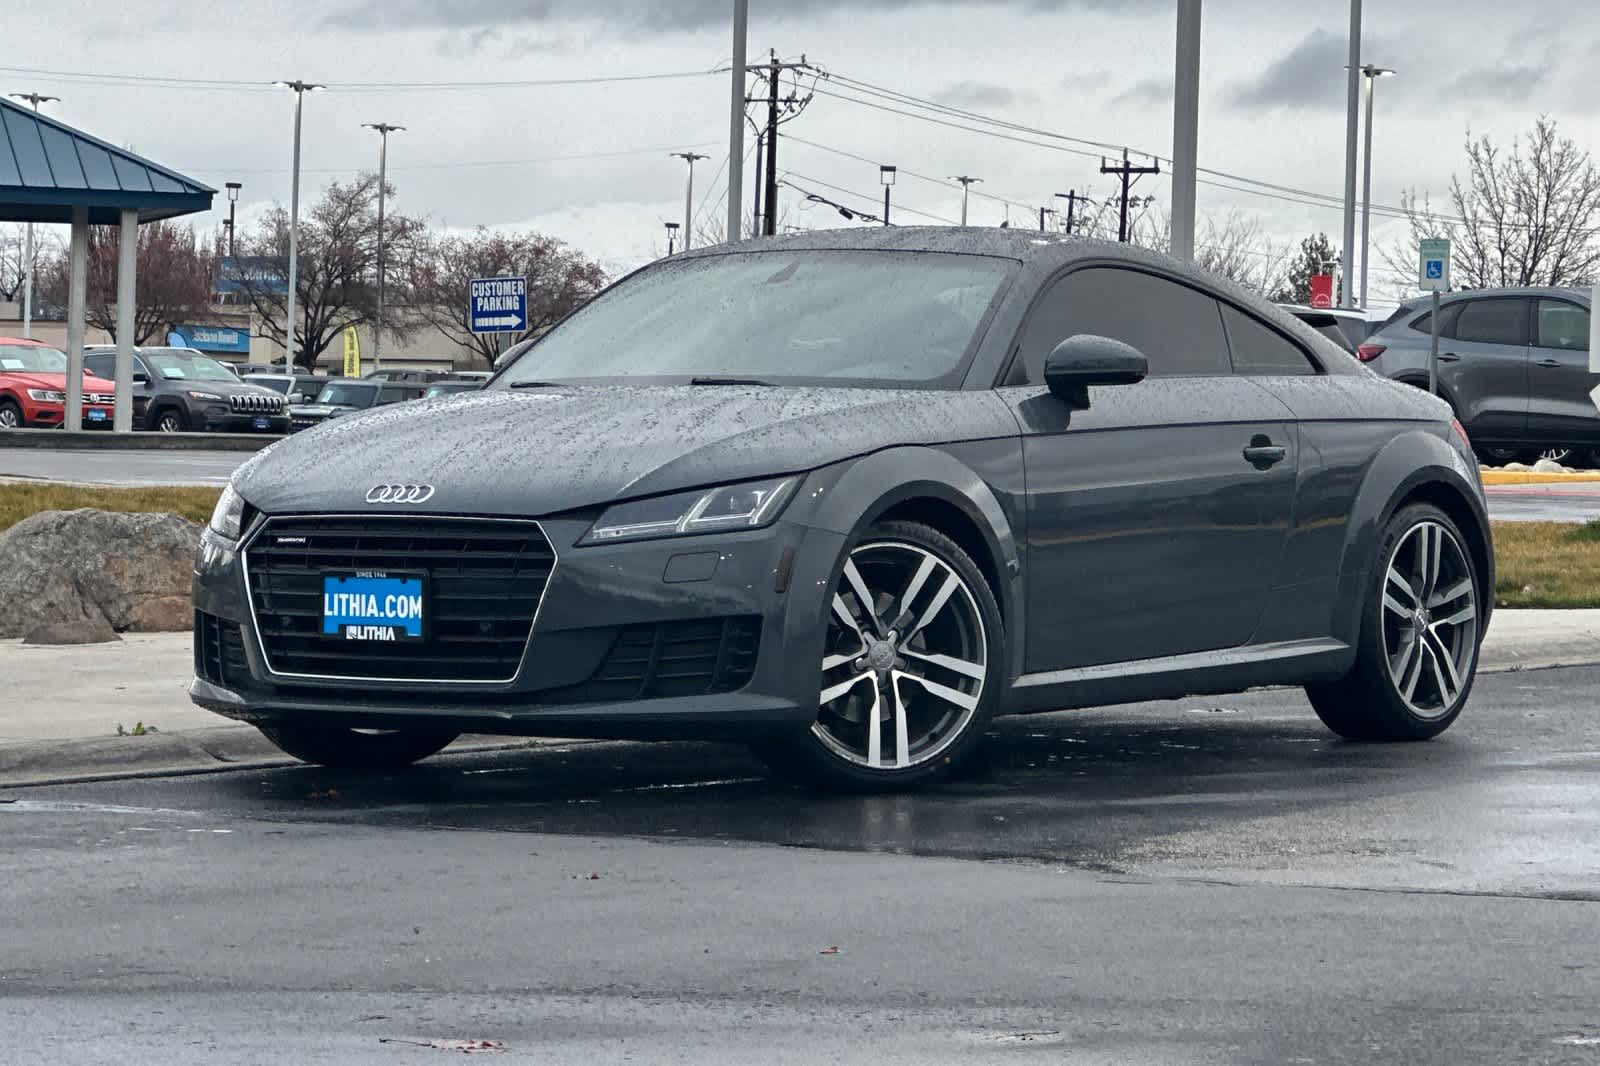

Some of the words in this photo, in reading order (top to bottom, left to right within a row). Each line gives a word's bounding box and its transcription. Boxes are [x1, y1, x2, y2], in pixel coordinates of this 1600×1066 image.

[472, 281, 524, 297] CUSTOMER
[477, 295, 520, 312] PARKING
[324, 593, 422, 619] LITHIA.COM
[357, 626, 395, 641] LITHIA
